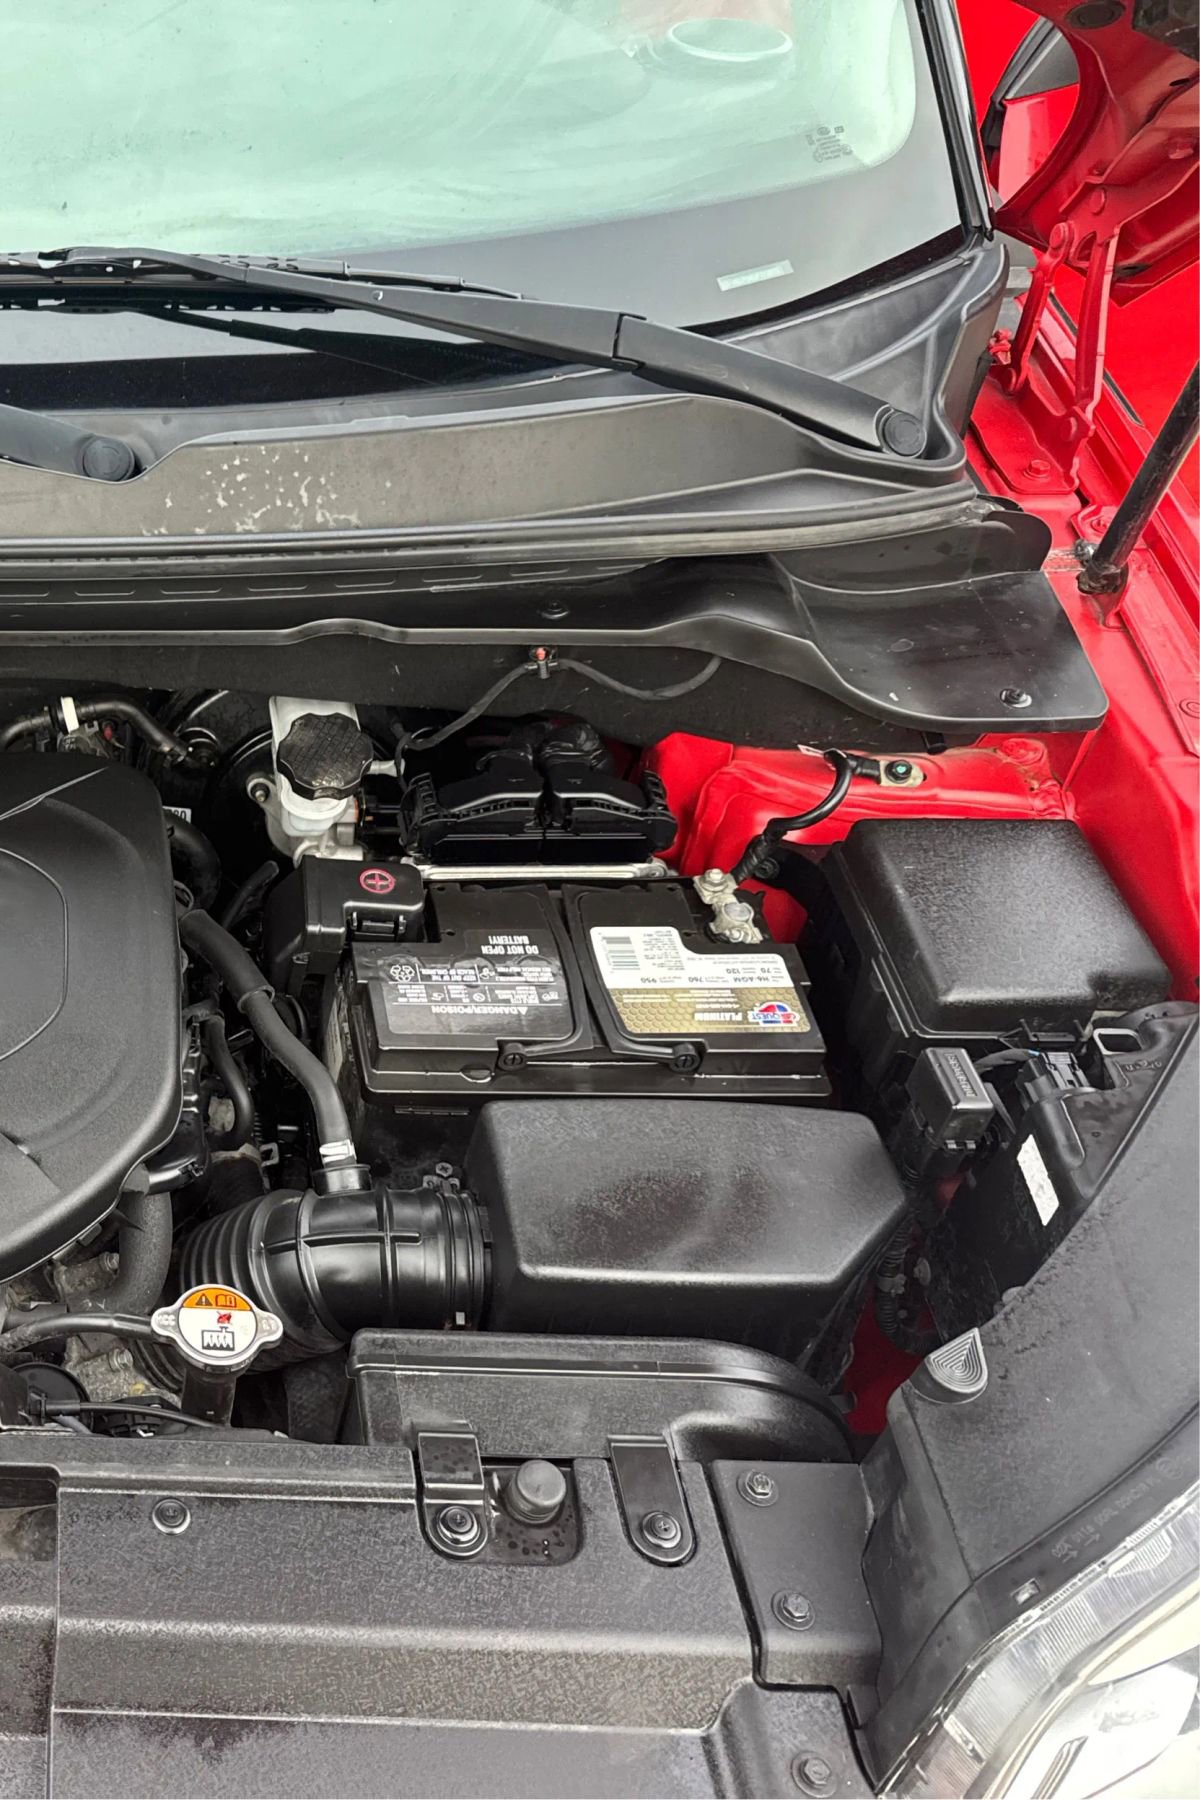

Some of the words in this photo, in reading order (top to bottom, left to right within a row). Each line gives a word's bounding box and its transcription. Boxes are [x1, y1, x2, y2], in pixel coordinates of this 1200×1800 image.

[489, 935, 529, 945] BATTERY!
[481, 945, 505, 955] OPEN
[507, 944, 524, 955] NOT
[526, 944, 539, 955] DO
[695, 1012, 742, 1021] PLATINUM
